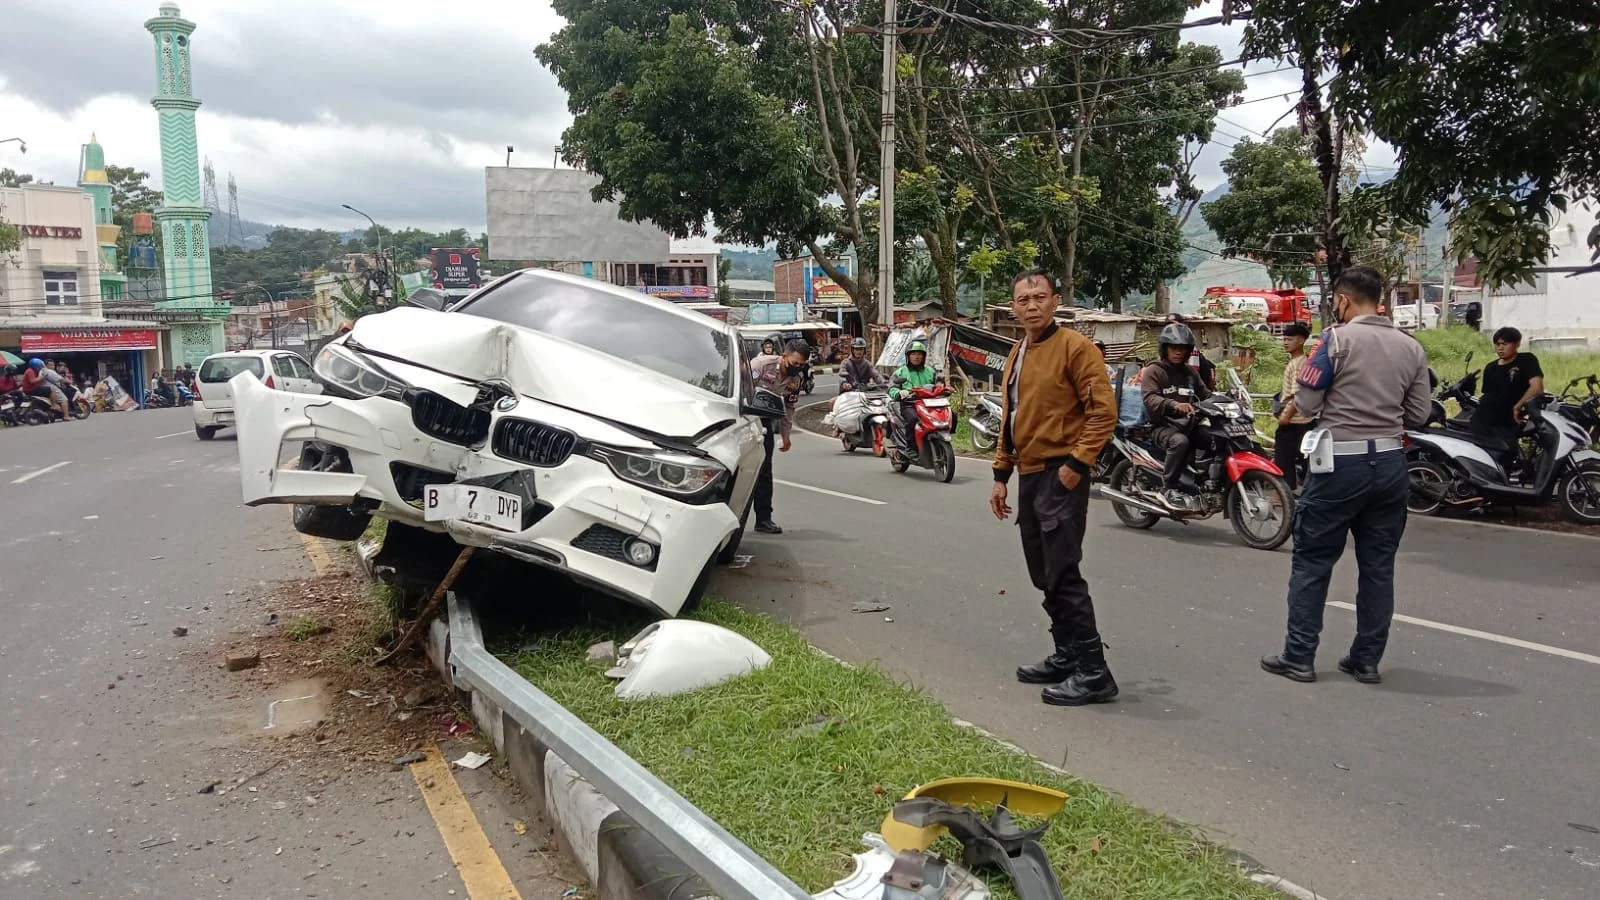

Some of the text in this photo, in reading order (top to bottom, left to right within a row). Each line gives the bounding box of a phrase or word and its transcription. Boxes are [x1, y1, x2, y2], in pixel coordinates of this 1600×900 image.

[429, 489, 518, 519] B 7 DYP
